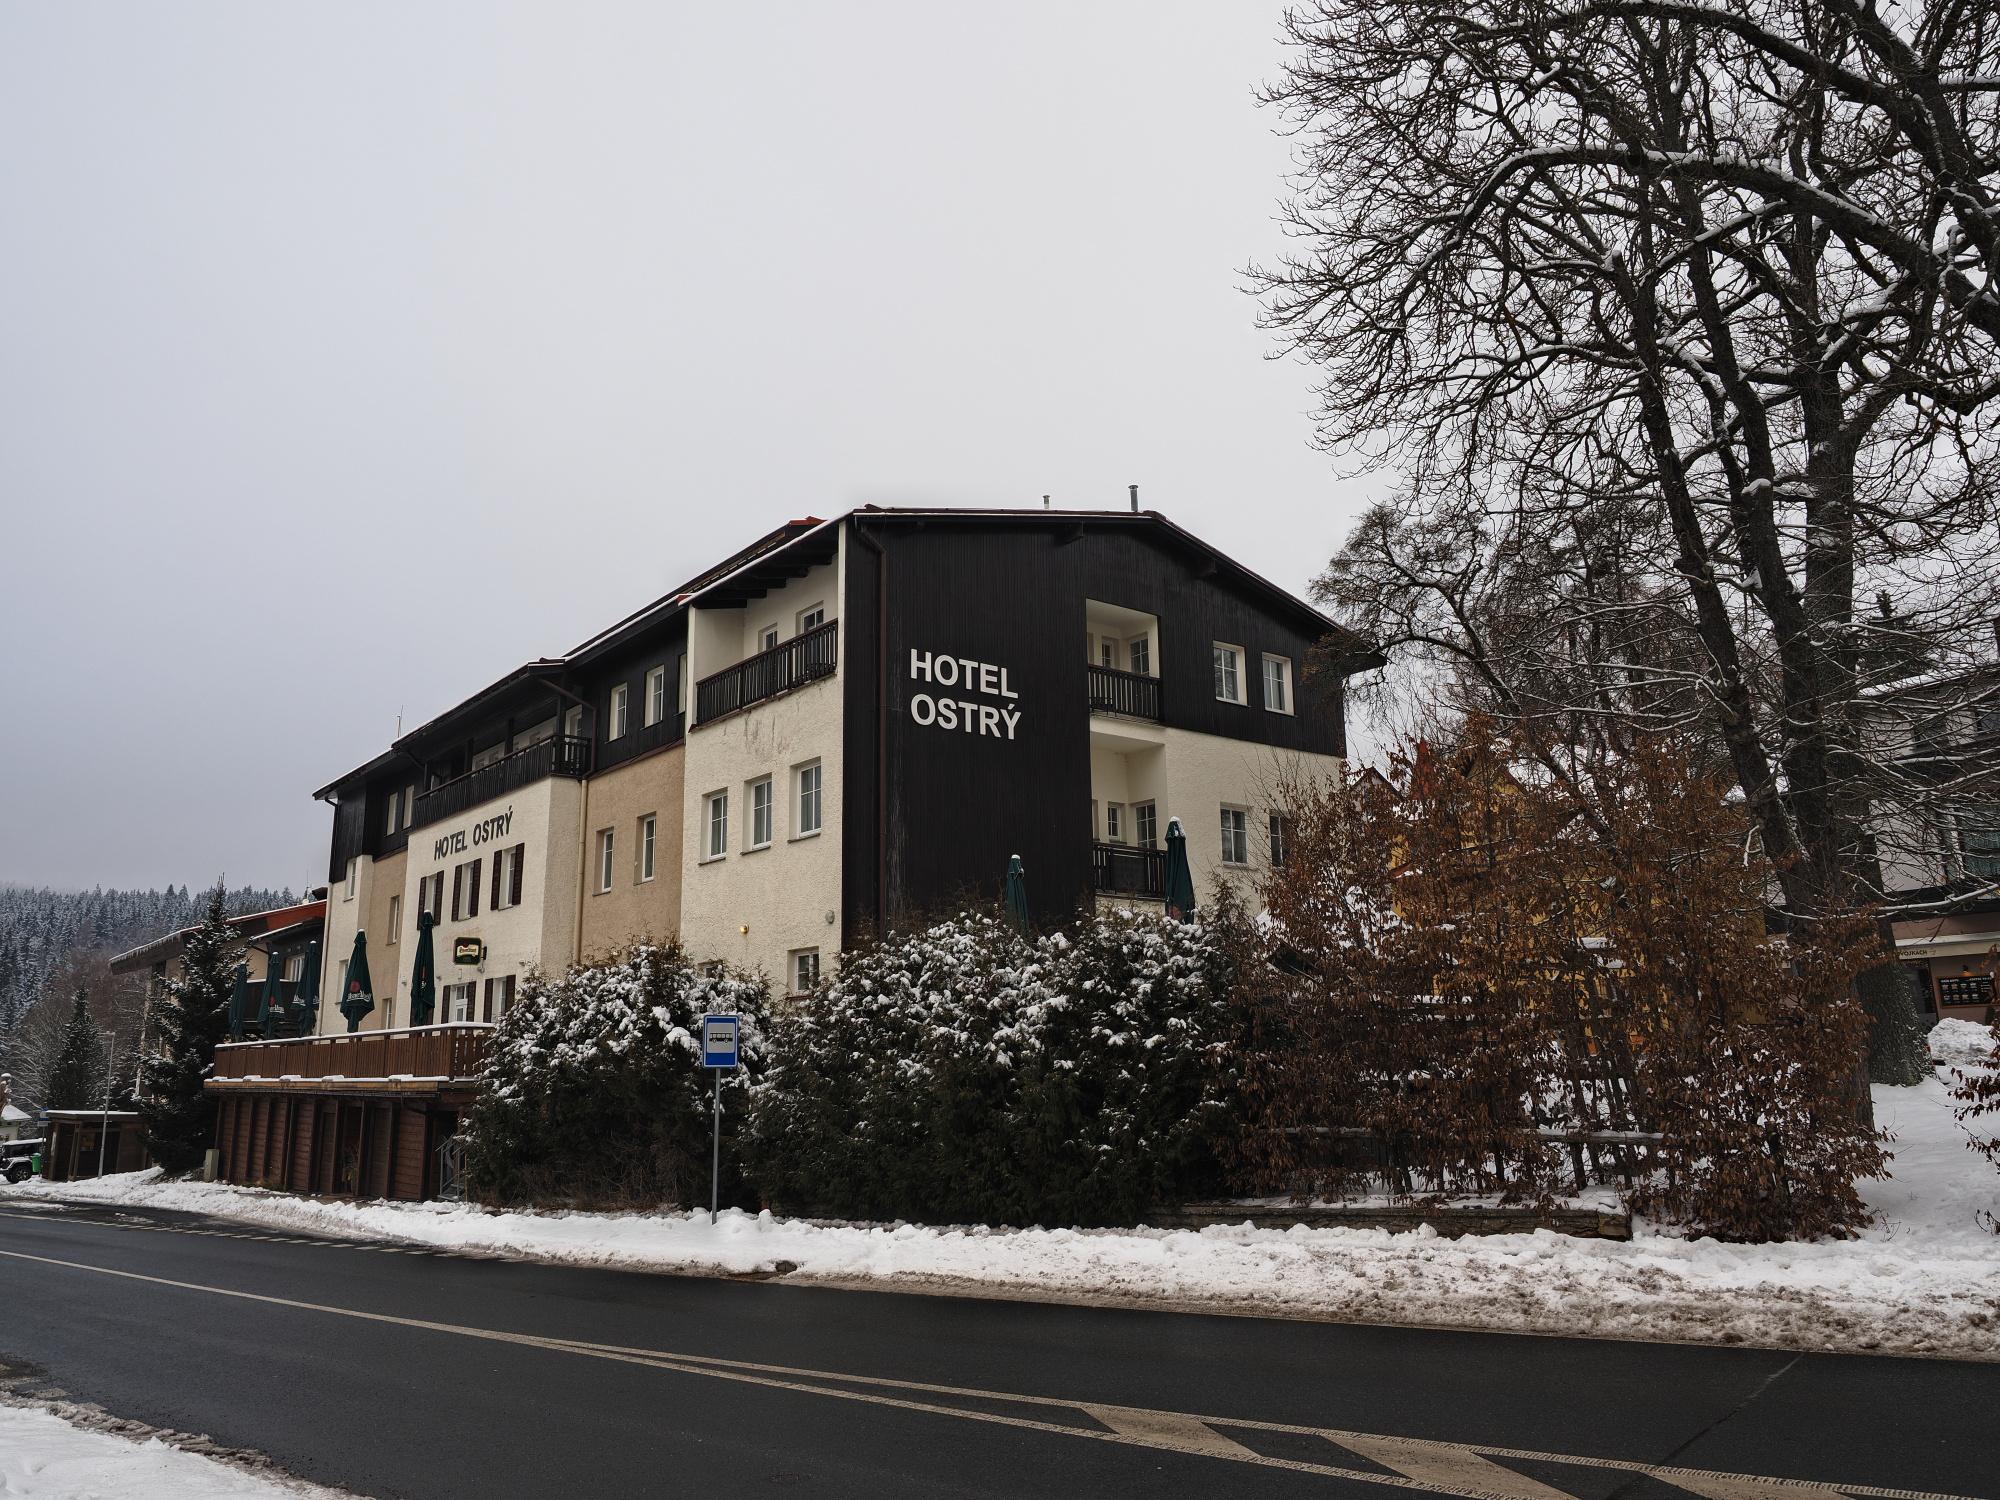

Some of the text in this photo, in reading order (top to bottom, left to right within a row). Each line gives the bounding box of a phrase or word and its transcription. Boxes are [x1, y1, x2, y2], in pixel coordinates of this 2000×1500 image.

[910, 648, 1019, 699] HOTEL
[910, 693, 1022, 740] OSTRÝ
[434, 805, 513, 861] HOTEL OSTRÝ
